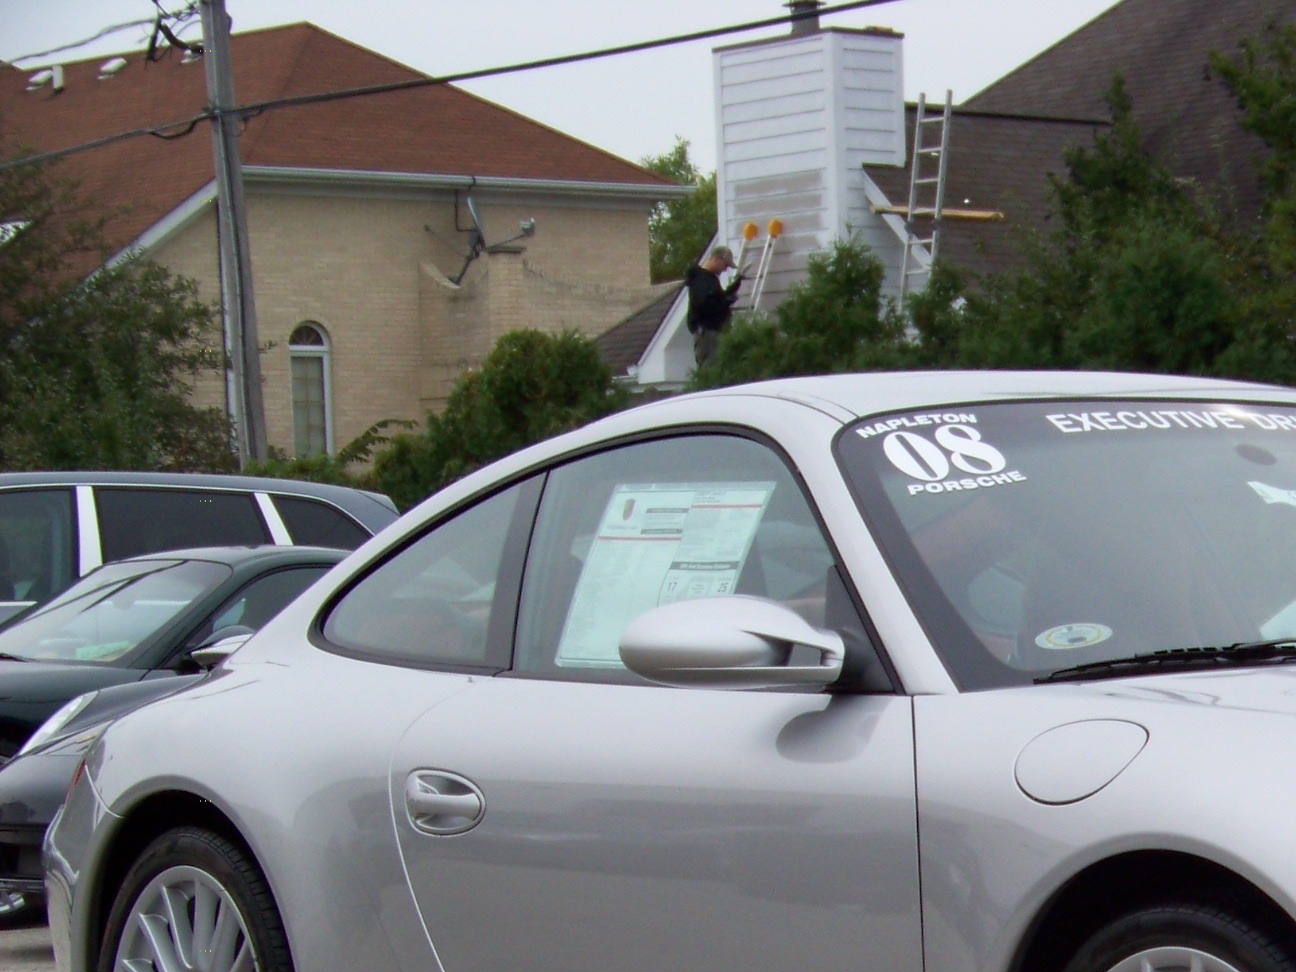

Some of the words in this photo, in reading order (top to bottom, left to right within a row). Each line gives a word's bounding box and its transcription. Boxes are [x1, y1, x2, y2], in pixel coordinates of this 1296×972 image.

[856, 413, 978, 439] NAPLETON
[1045, 410, 1245, 433] EXECUTIVE
[883, 424, 1006, 482] 08
[907, 470, 1027, 496] PORSCHE
